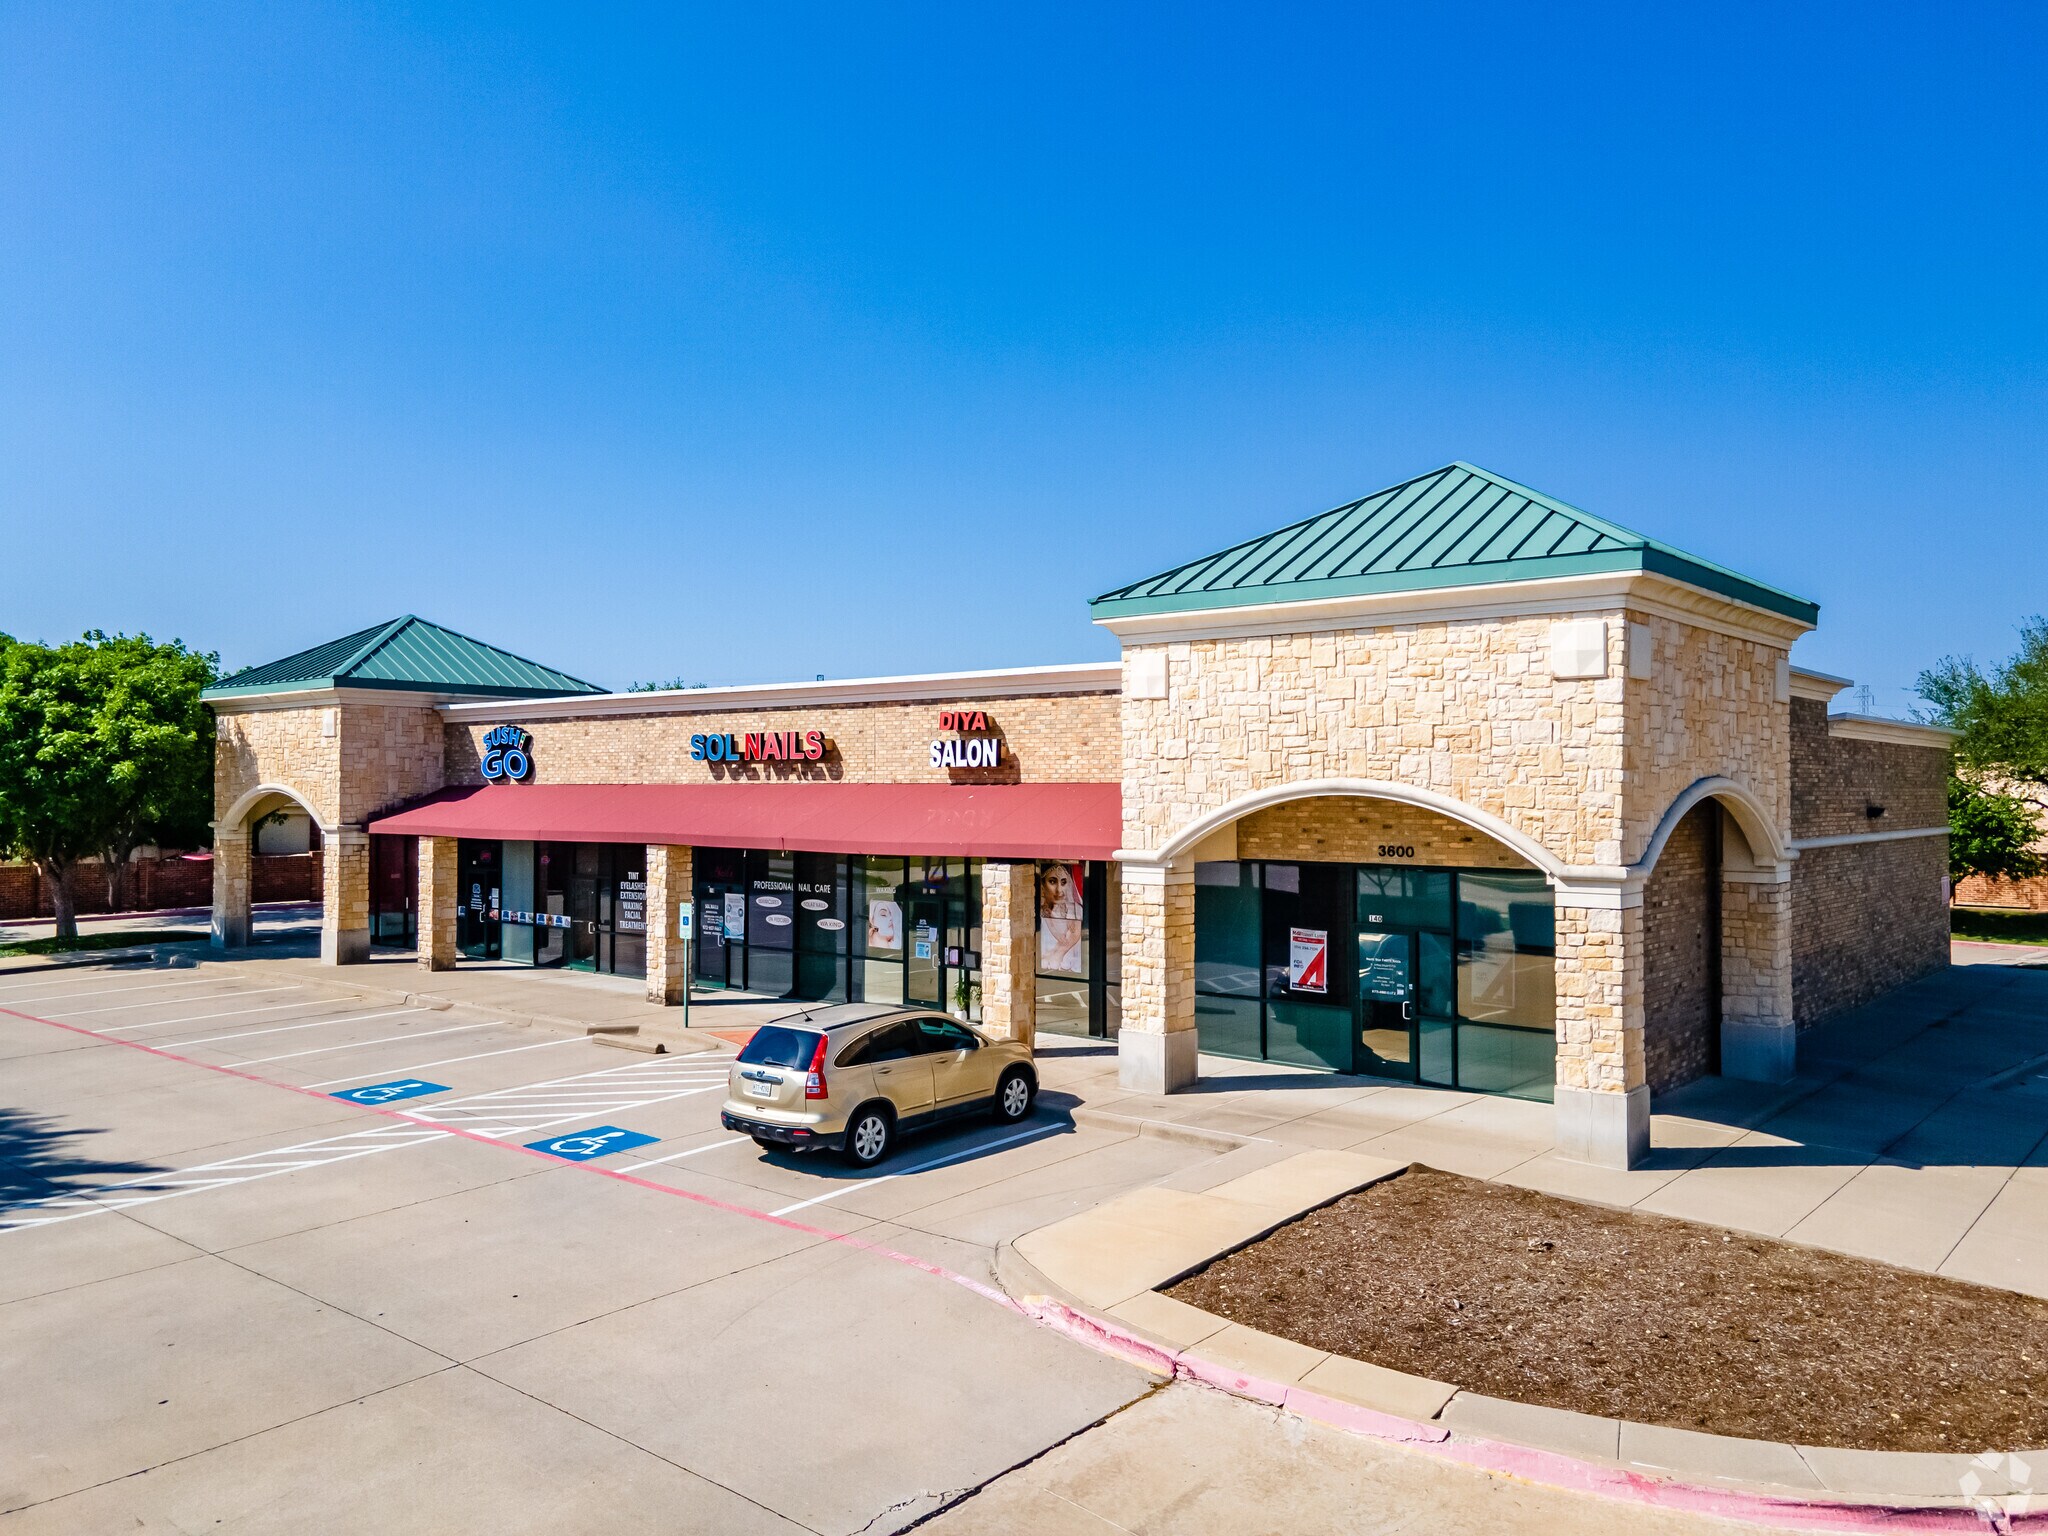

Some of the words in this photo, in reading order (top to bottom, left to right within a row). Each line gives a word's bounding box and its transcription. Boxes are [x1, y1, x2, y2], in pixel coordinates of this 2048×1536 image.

[939, 711, 987, 731] DIYA
[483, 726, 527, 750] SUSHI
[690, 733, 739, 761] SOL
[744, 730, 823, 761] NAILS
[929, 738, 998, 768] SALON
[481, 749, 528, 779] GO
[1378, 845, 1414, 858] 3600
[628, 871, 639, 880] TINT
[753, 880, 794, 892] PROFESSIONAL
[798, 883, 812, 893] NAIL
[814, 883, 831, 894] CARE
[622, 901, 643, 911] WAXING
[624, 910, 641, 920] FACIAL
